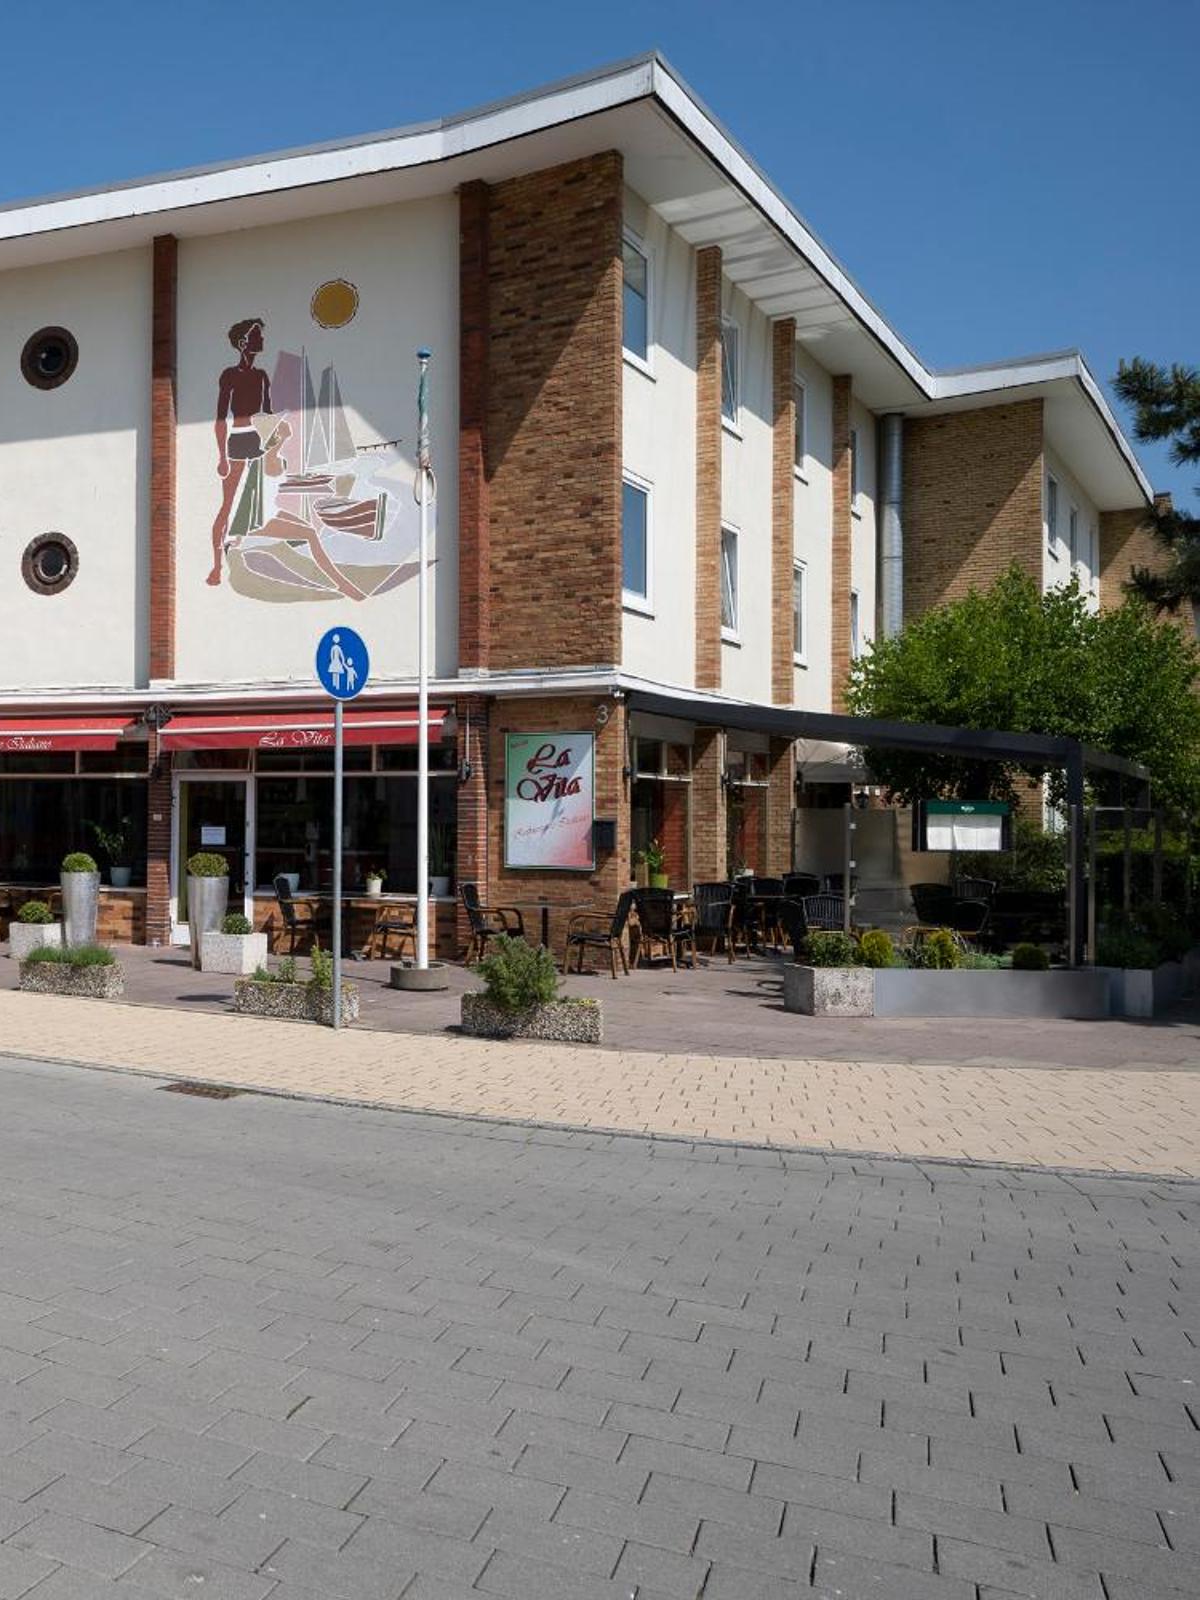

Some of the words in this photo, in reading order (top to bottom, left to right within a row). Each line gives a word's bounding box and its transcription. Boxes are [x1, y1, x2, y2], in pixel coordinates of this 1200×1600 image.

[597, 704, 609, 724] 3
[258, 730, 286, 747] La
[291, 729, 330, 746] Vita
[526, 743, 573, 775] La
[516, 773, 582, 804] Vita
